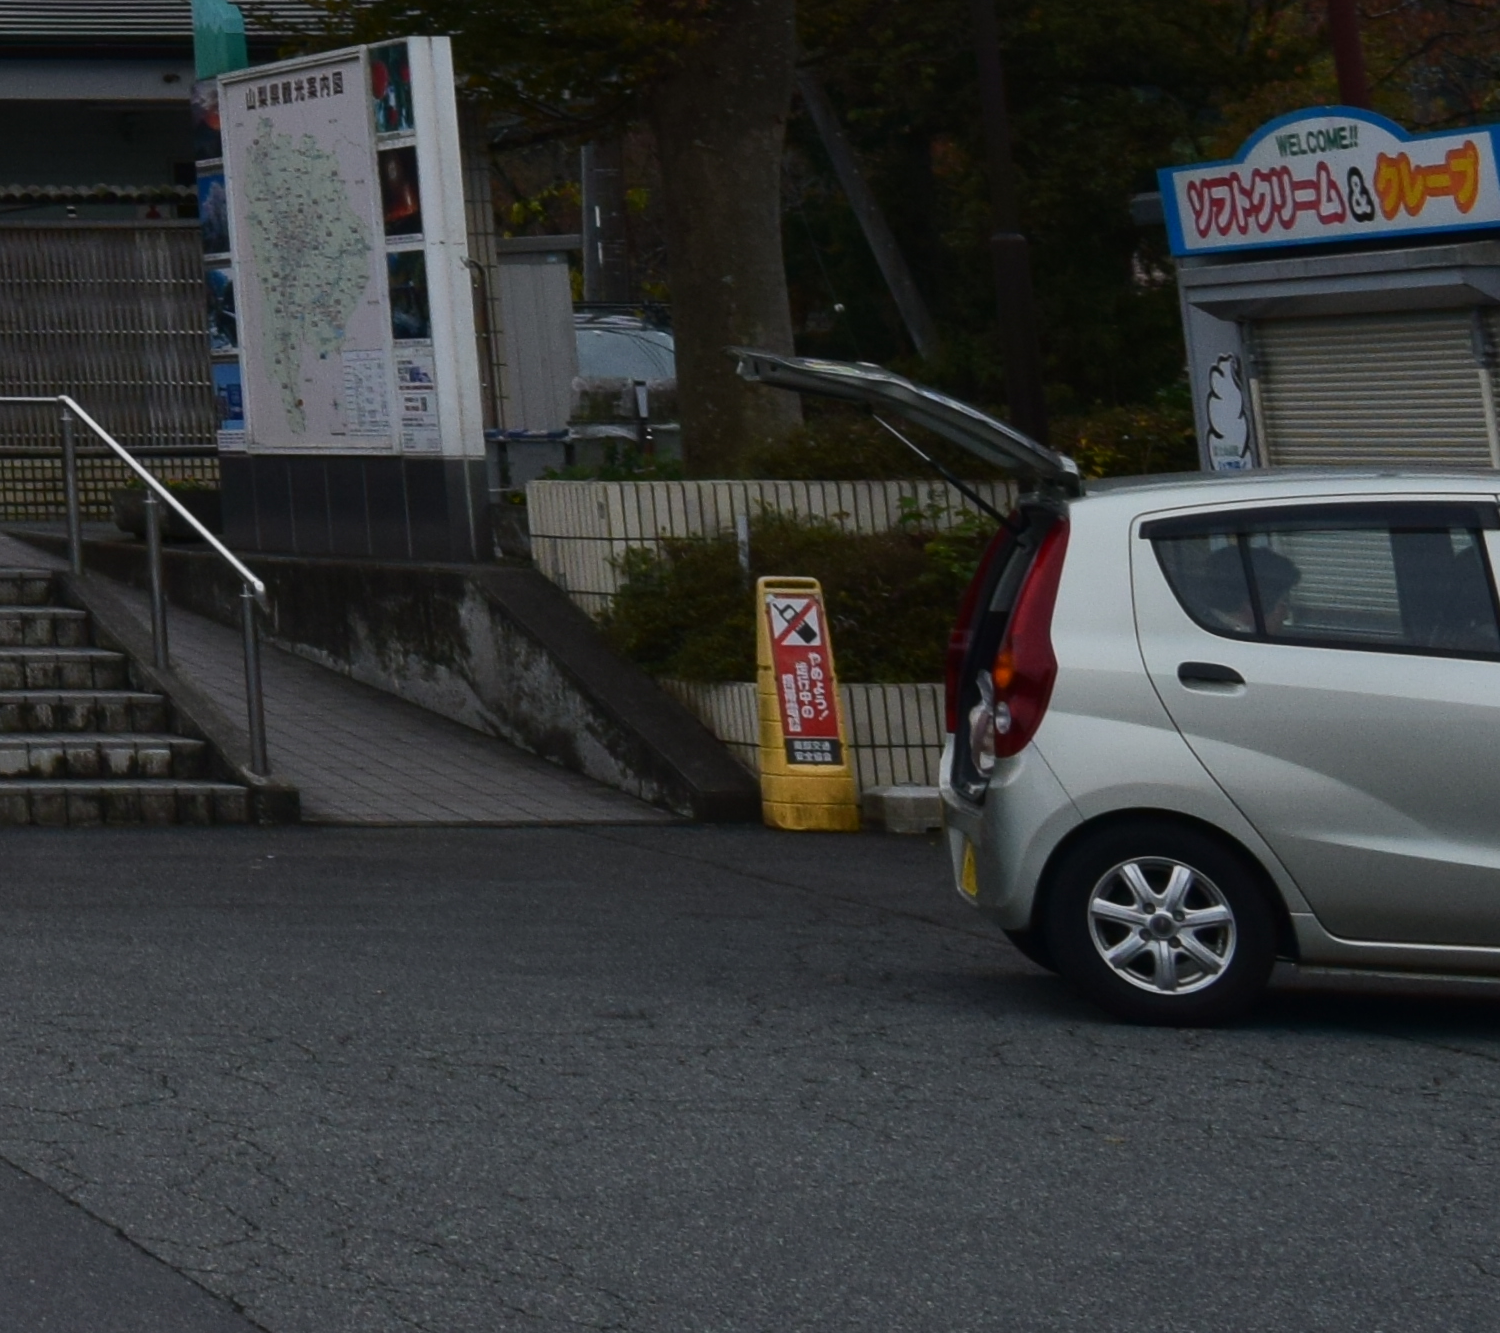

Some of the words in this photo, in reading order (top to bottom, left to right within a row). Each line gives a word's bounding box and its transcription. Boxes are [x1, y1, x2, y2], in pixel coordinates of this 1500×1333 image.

[245, 71, 344, 111] 山梨県観光案内図
[1276, 123, 1360, 158] WELCOME!!
[1187, 161, 1346, 238] ソフトクリーム
[1374, 140, 1480, 221] クレープ
